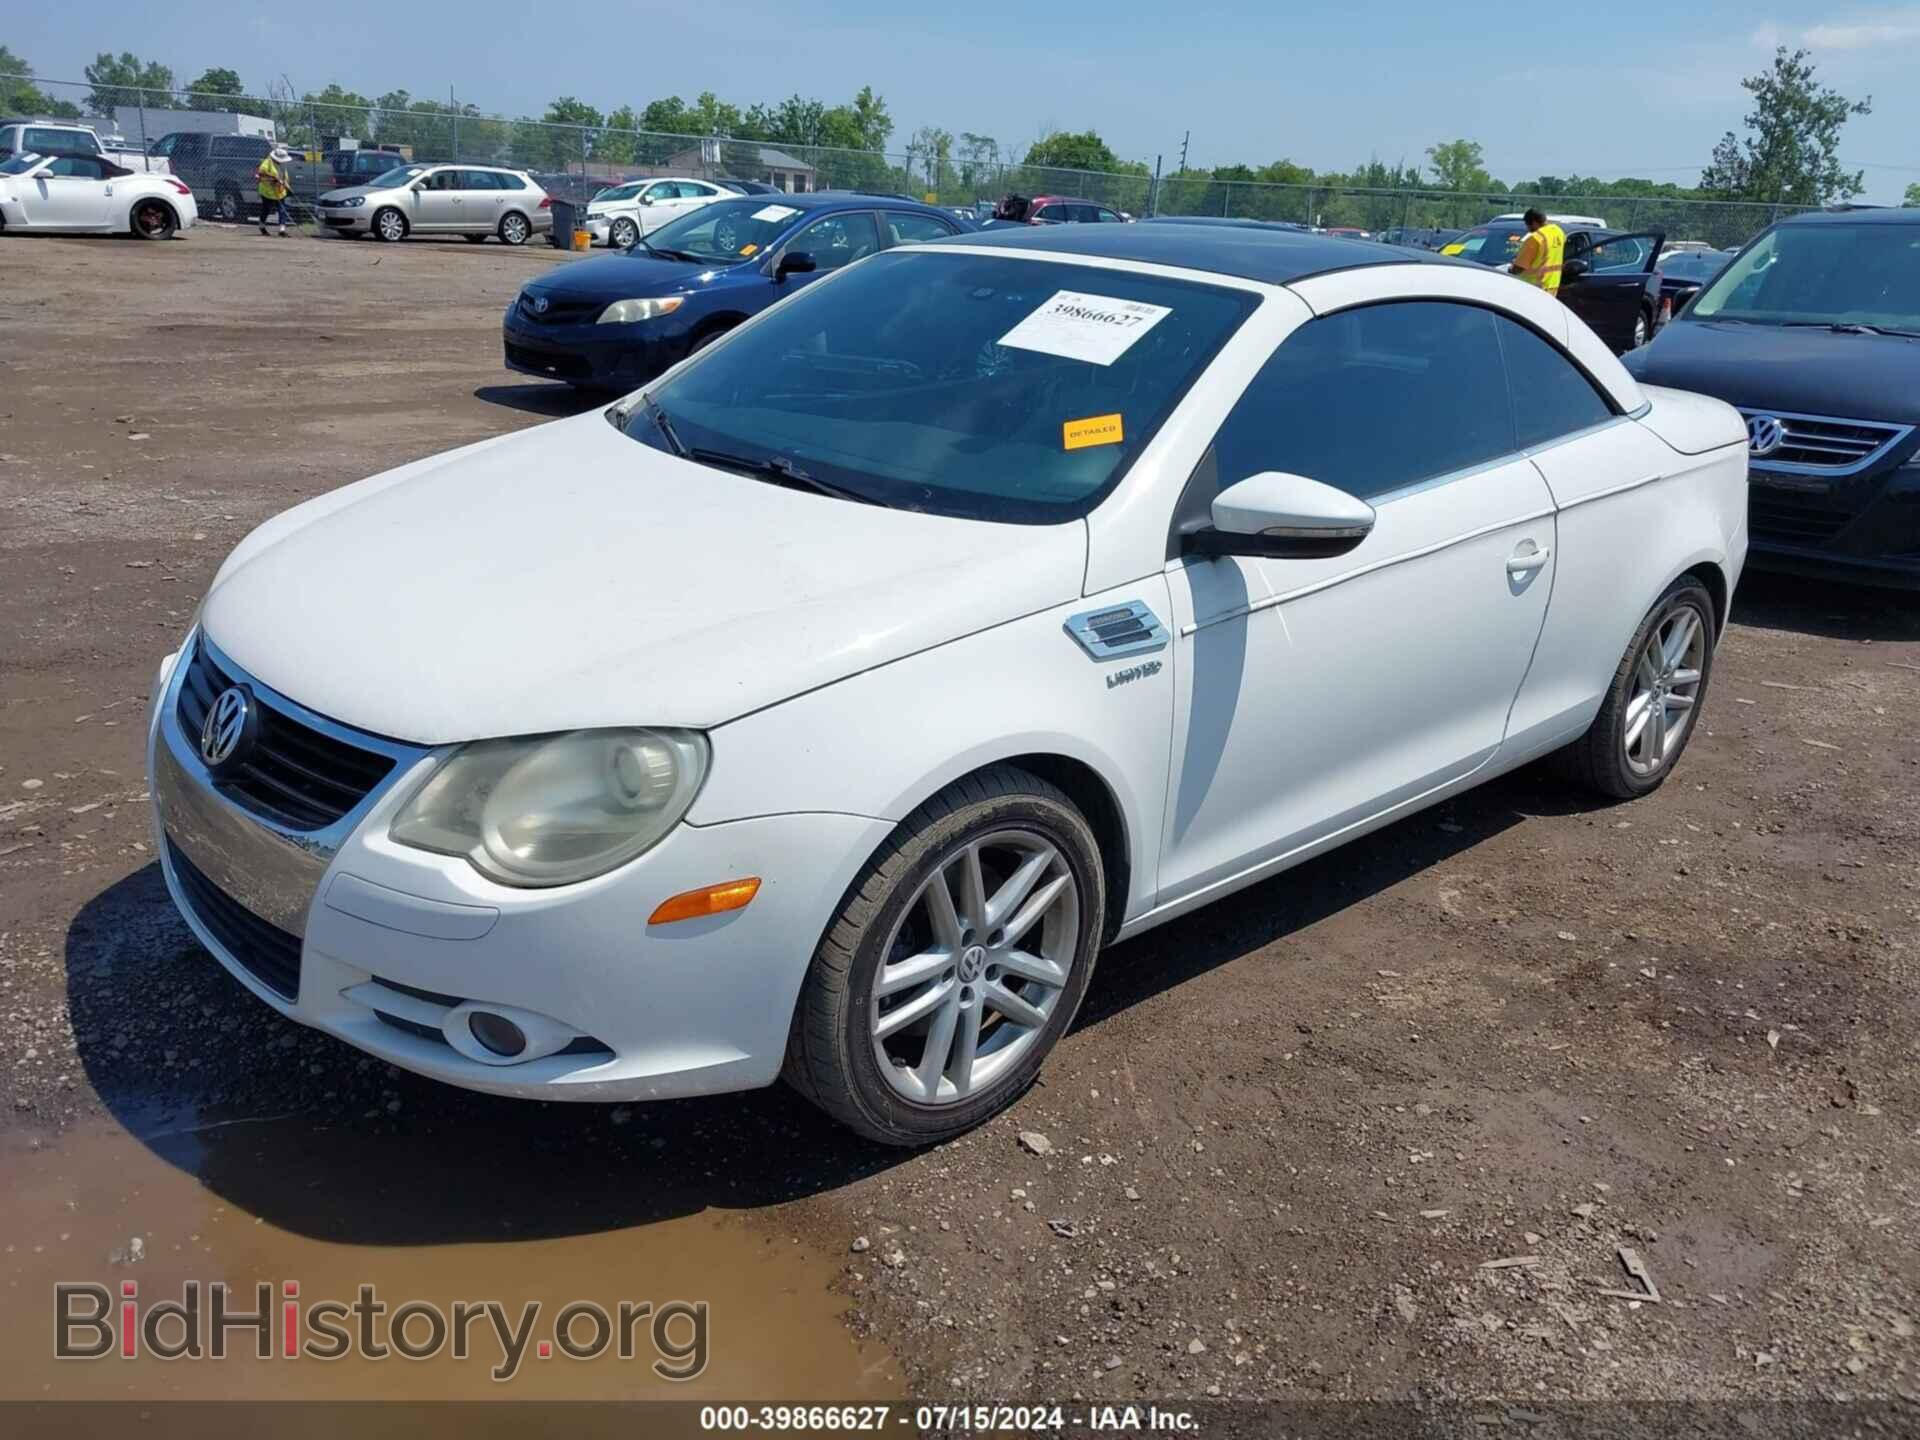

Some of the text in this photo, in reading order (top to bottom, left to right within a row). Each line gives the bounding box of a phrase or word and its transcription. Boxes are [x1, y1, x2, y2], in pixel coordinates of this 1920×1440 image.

[1047, 303, 1144, 327] 39866627
[1069, 424, 1117, 439] DETAILED
[1105, 660, 1163, 690] LIMITED
